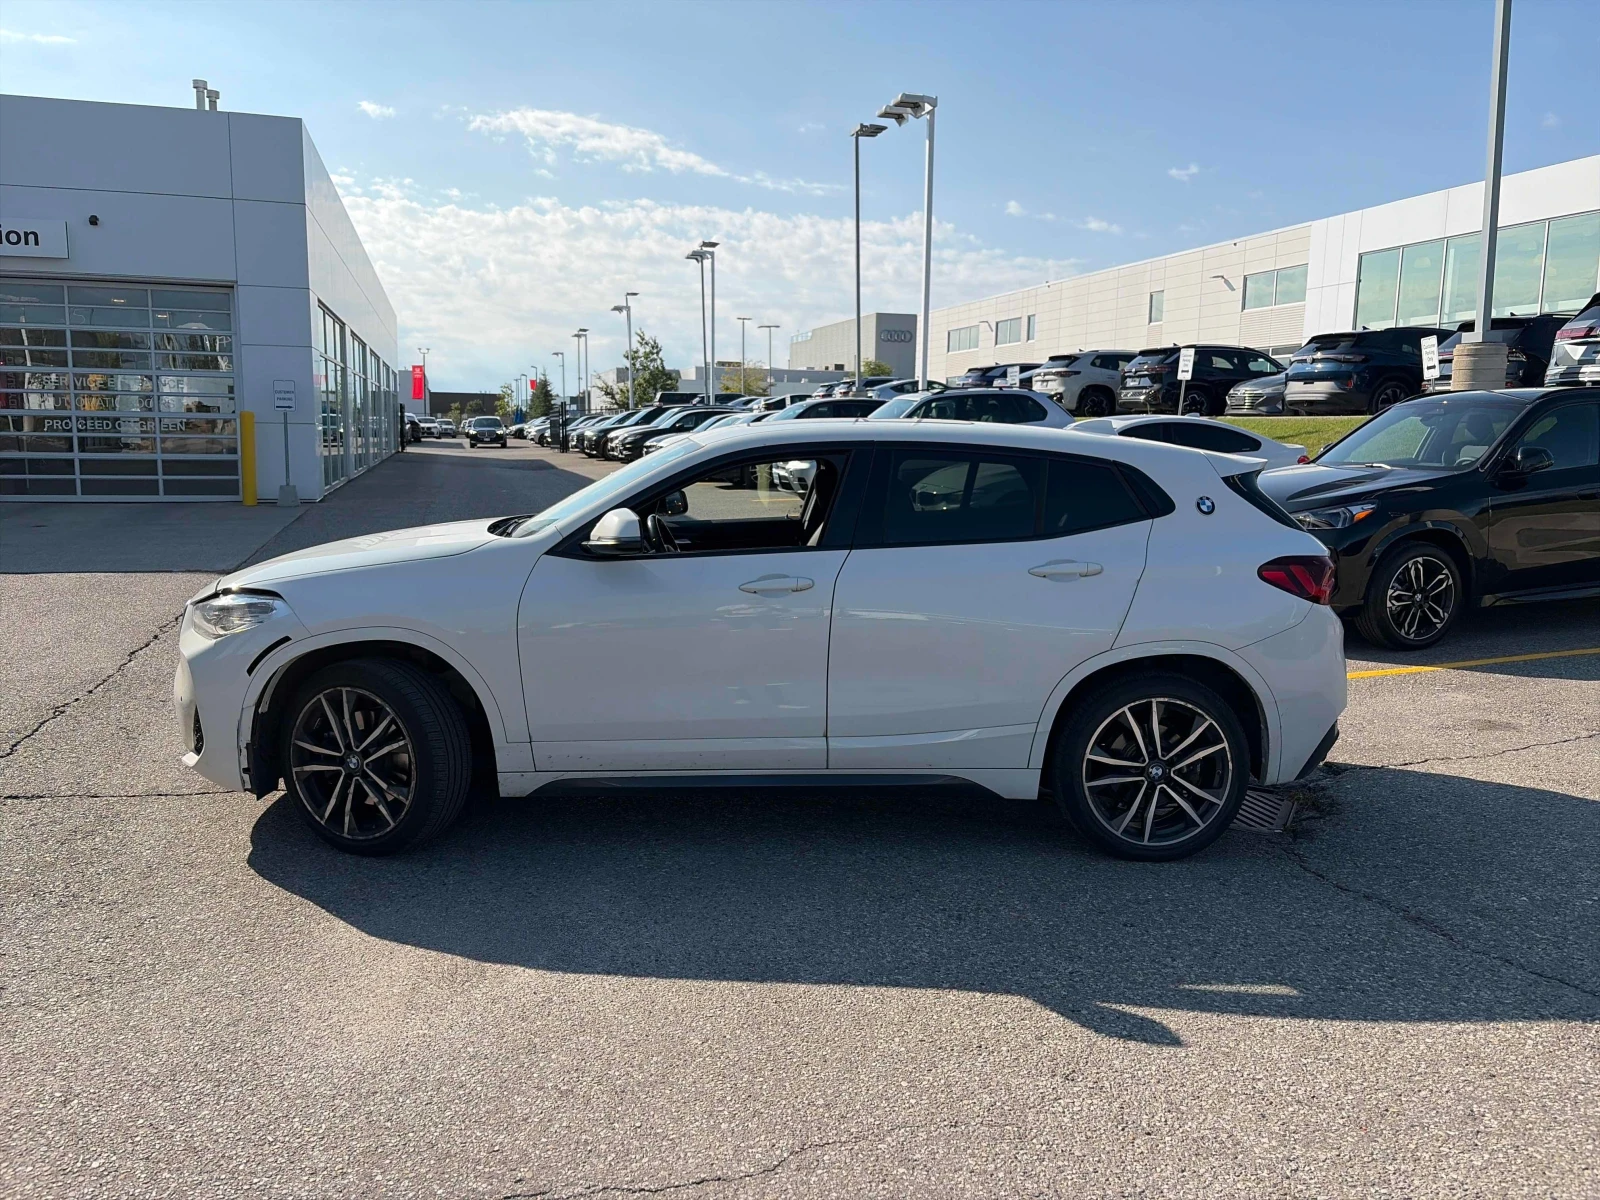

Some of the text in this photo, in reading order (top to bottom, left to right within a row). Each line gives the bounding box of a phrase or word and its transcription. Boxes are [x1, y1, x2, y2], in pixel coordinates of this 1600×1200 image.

[43, 376, 184, 389] SERVICE EANCE
[128, 398, 175, 409] OORS
[44, 419, 112, 430] PROCEED
[138, 420, 185, 432] GREEN
